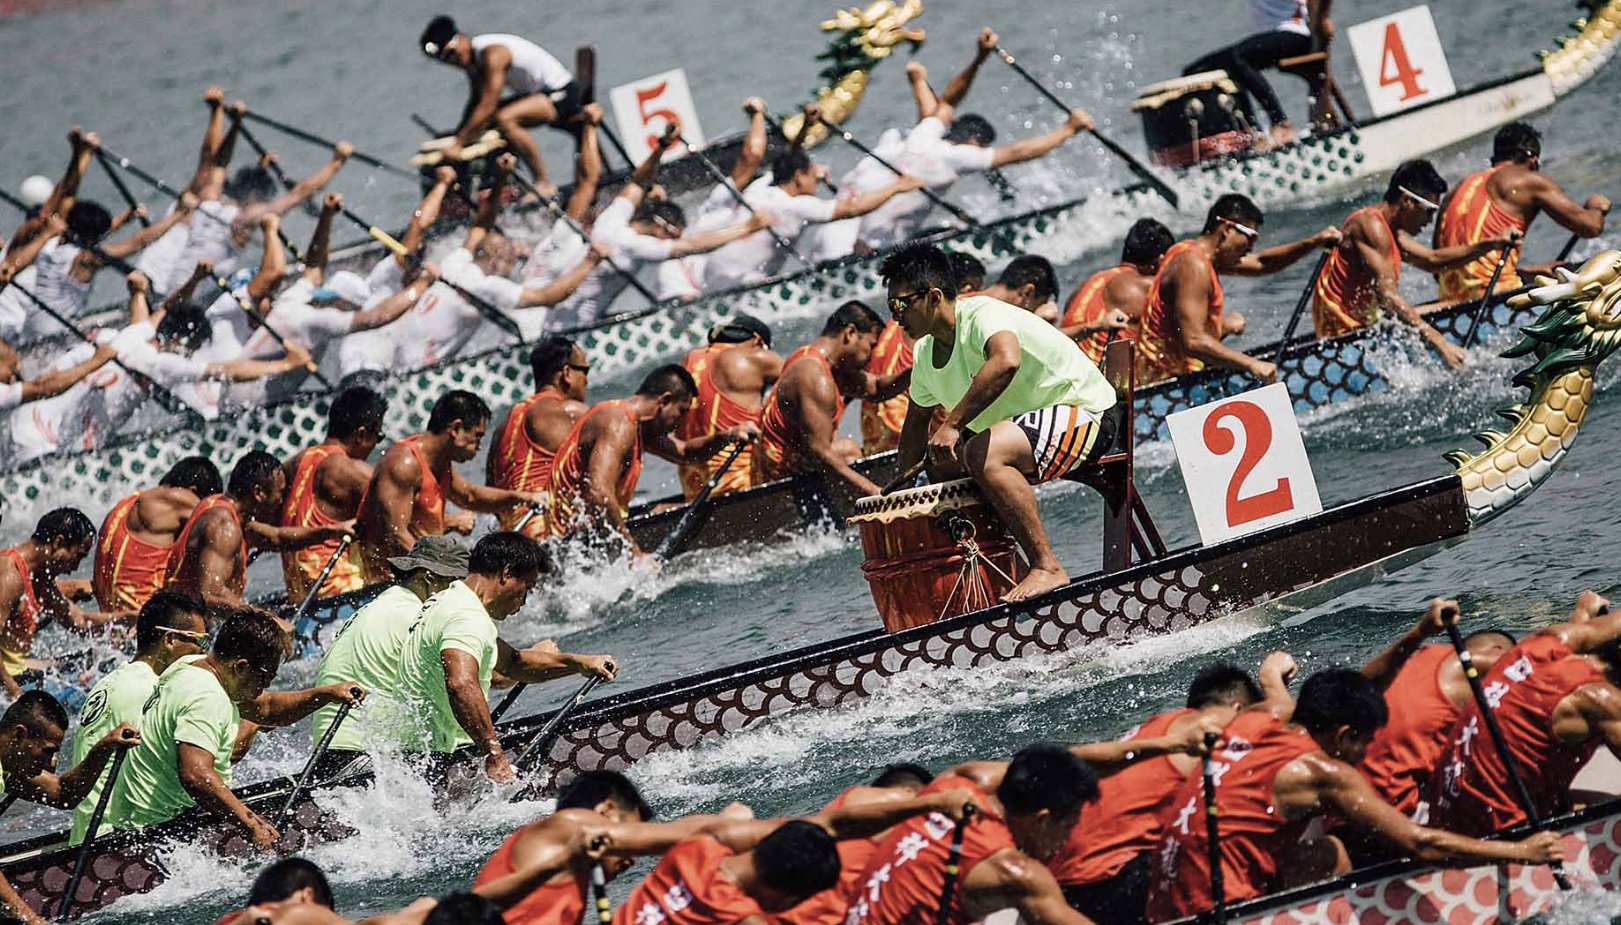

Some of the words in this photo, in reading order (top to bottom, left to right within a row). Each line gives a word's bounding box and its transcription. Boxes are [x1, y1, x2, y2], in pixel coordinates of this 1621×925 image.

[1379, 22, 1428, 102] 4
[636, 81, 682, 152] 5
[1201, 400, 1295, 528] 2
